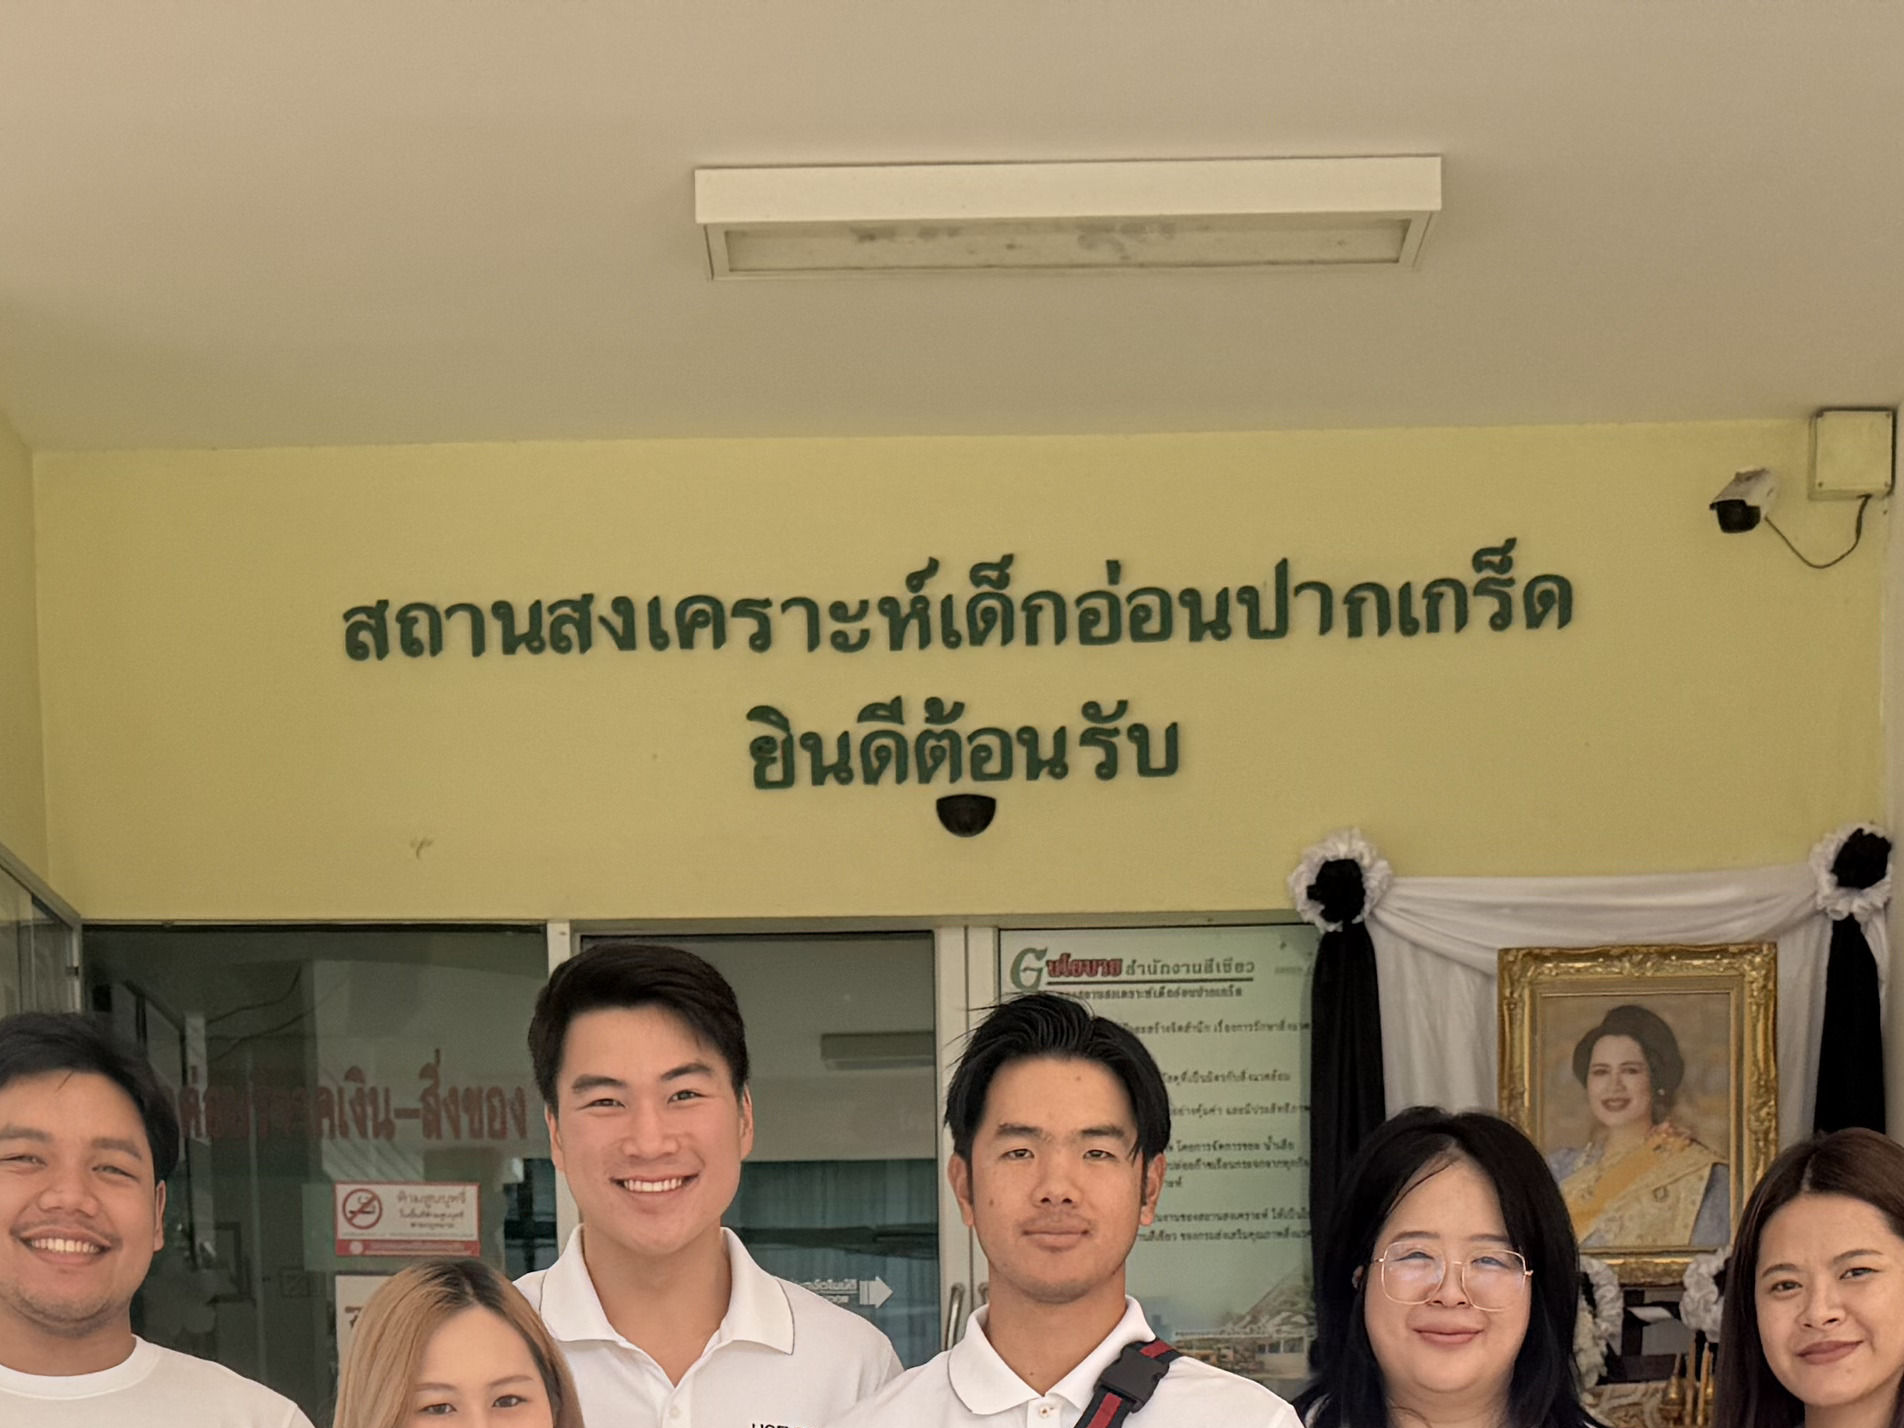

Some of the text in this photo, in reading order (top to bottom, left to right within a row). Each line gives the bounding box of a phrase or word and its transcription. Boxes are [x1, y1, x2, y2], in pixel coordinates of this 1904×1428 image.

[342, 538, 1575, 662] สถานสงเคราะห์เด็กอ่อนปากเกร็ด
[746, 696, 1180, 790] ยินดีต้อนรับ
